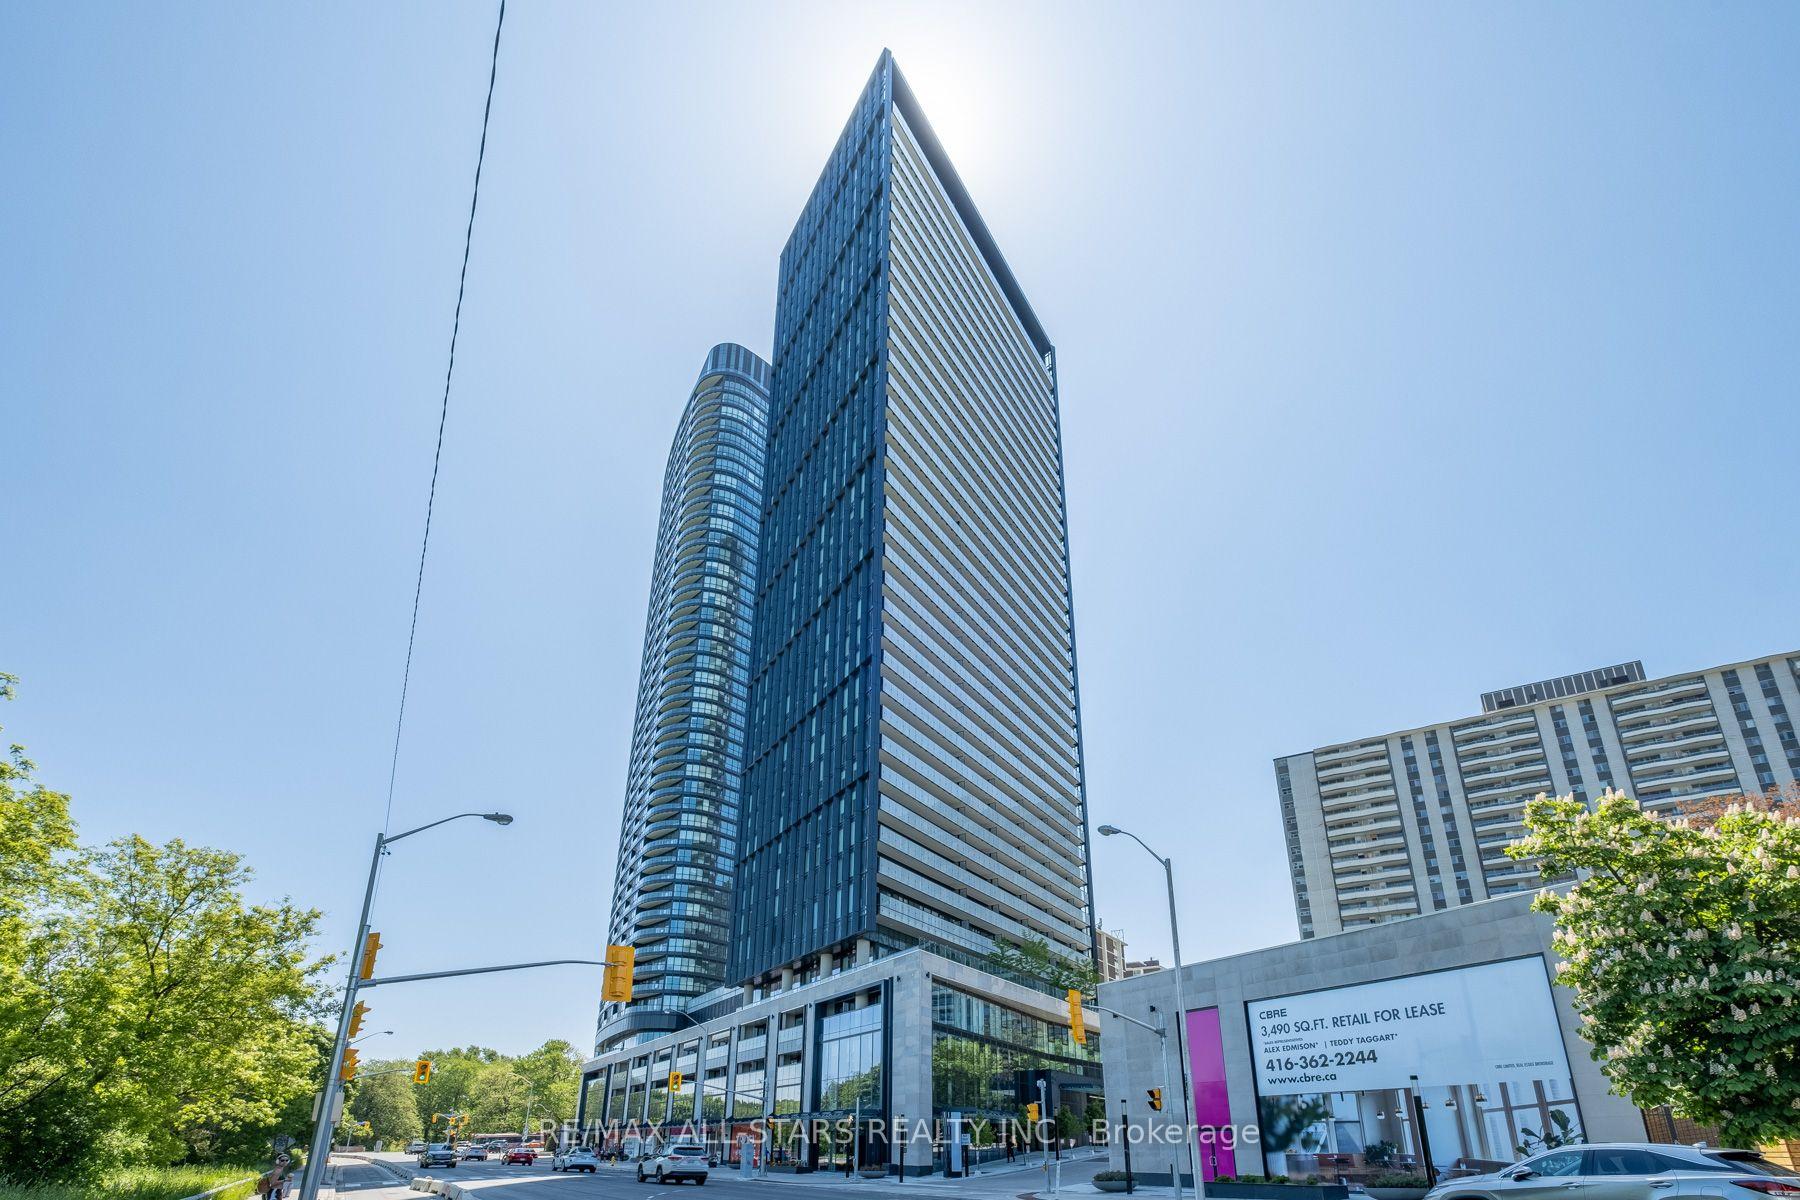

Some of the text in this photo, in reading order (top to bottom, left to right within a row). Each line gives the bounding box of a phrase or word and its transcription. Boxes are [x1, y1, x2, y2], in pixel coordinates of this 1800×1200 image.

[1259, 1008, 1287, 1020] CBRE
[1261, 1002, 1445, 1038] 3,490 SQ.FT. RETAIL FOR LEASE
[1263, 1046, 1281, 1054] ALEX
[1330, 1038, 1354, 1047] TEDDY
[1266, 1049, 1377, 1071] 416-362-2244
[1267, 1073, 1337, 1085] www.cbre.ca
